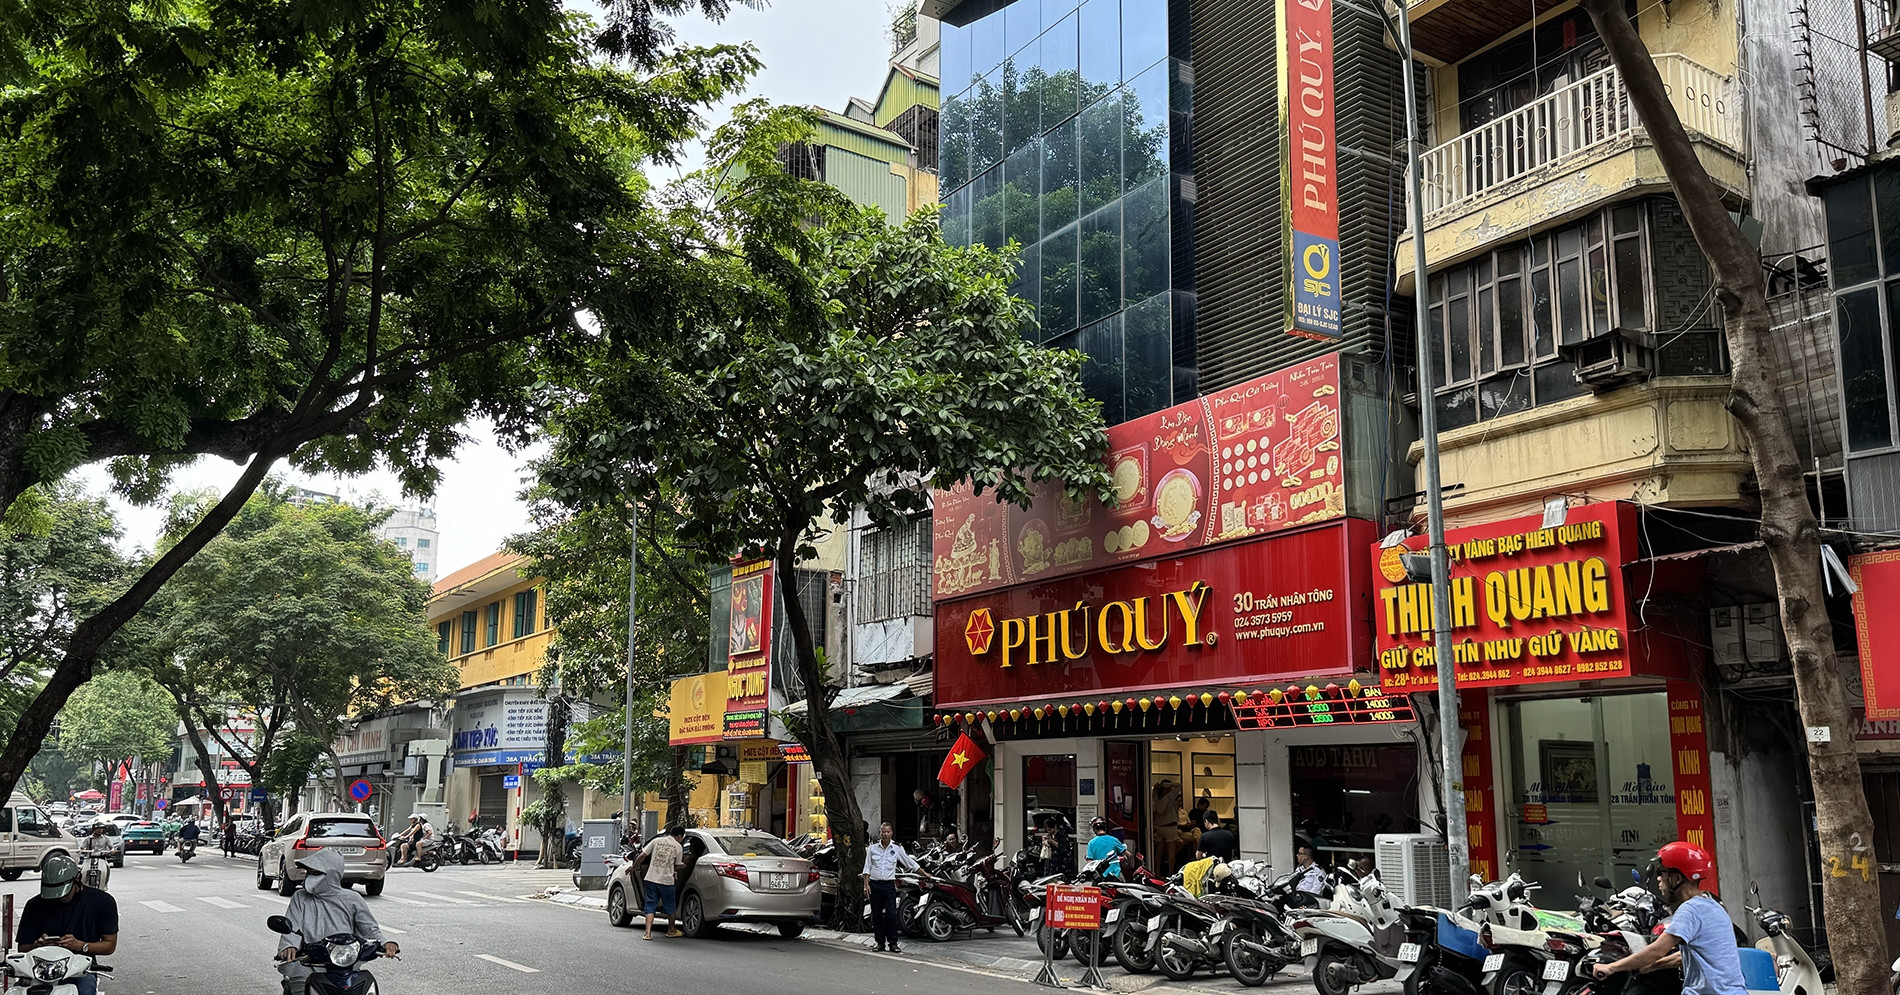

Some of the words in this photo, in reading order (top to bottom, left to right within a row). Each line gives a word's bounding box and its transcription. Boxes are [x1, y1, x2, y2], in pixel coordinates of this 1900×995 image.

[1296, 26, 1324, 118] QUÝ
[1298, 120, 1328, 214] PHÚ
[1304, 278, 1331, 297] SJC
[1298, 302, 1311, 316] ĐẠI
[1312, 304, 1322, 318] LÝ
[1323, 308, 1339, 322] SJC
[1464, 539, 1495, 559] VÀNG
[1498, 534, 1523, 555] BẠC
[1558, 520, 1601, 545] QUANG
[1233, 591, 1253, 613] 30
[1254, 594, 1279, 610] TRẦN
[1280, 593, 1306, 607] NHÂN
[1307, 587, 1333, 603] TÔNG
[1485, 557, 1609, 628] QUANG
[1000, 600, 1092, 668] PHÚ
[1098, 580, 1212, 655] QUÝ
[1234, 616, 1249, 628] 024
[1250, 613, 1270, 625] 3573
[1271, 611, 1292, 622] 5959
[1235, 621, 1324, 640] www.phuquy.com.vn
[1381, 644, 1407, 668] GIỮ
[1452, 638, 1478, 663] TÍN
[1484, 637, 1522, 661] NHƯ
[1528, 630, 1561, 657] GIỮ
[1569, 625, 1619, 652] VÀNG
[1523, 667, 1535, 677] 024
[1537, 666, 1553, 676] 3944
[1554, 665, 1571, 675] 8627
[1576, 663, 1594, 673] 0982
[1595, 661, 1608, 671] 852
[1609, 660, 1623, 670] 628
[1364, 686, 1382, 697] BÁN
[1671, 699, 1689, 710] CÔNG
[1691, 700, 1699, 709] TY
[1254, 708, 1269, 716] SJC
[1686, 715, 1702, 735] QUANG
[361, 730, 381, 750] MINH
[469, 721, 483, 749] TIẾP
[484, 723, 499, 748] XÚC
[1464, 751, 1480, 777] KÍNH
[1678, 745, 1700, 775] KÍNH
[1465, 786, 1483, 812] CHÀO
[1611, 795, 1619, 804] 28
[1681, 785, 1704, 815] CHÀO
[1469, 821, 1482, 849] QUÝ
[1850, 832, 1867, 852] 2
[1829, 855, 1869, 882] 24
